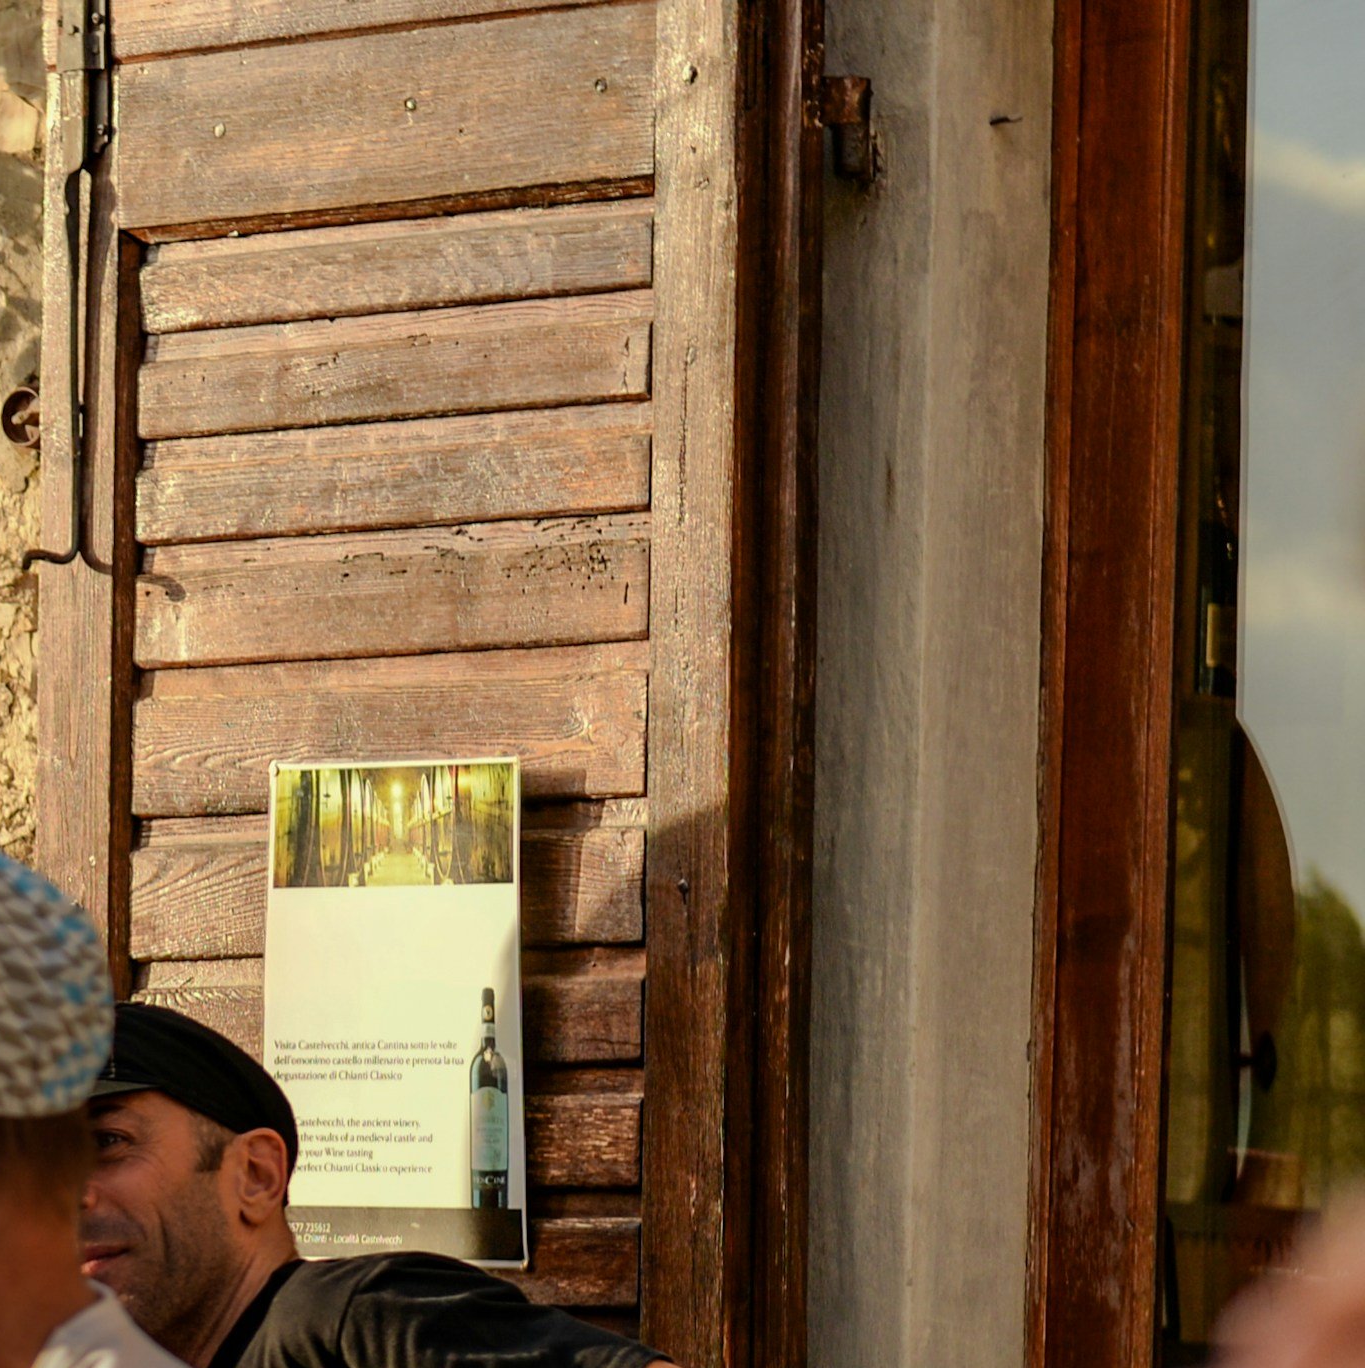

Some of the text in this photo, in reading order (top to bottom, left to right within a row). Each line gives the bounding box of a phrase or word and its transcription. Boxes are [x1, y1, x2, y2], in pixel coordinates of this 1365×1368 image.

[274, 1040, 296, 1050] Visita
[352, 1040, 375, 1050] antica
[377, 1040, 408, 1050] Cantina
[410, 1041, 429, 1050] sotto
[430, 1040, 437, 1050] le
[439, 1040, 458, 1050] volte
[332, 1055, 362, 1065] castello
[364, 1055, 404, 1065] millenario
[412, 1057, 442, 1068] prenota
[443, 1056, 450, 1065] la
[452, 1057, 464, 1065] tua
[274, 1070, 403, 1082] degustazione di Chianti Classico
[347, 1117, 360, 1127] the
[362, 1117, 391, 1127] ancient
[300, 1132, 313, 1141] the
[316, 1132, 338, 1141] vaults
[340, 1132, 349, 1142] of
[356, 1132, 392, 1142] medieval
[394, 1132, 416, 1142] castle
[418, 1133, 433, 1143] and
[305, 1150, 323, 1158] your
[324, 1147, 345, 1157] Wine
[346, 1148, 373, 1160] tasting
[324, 1163, 353, 1173] Chianti
[355, 1163, 387, 1173] Classico
[389, 1164, 432, 1175] experience
[303, 1233, 328, 1243] Chianti
